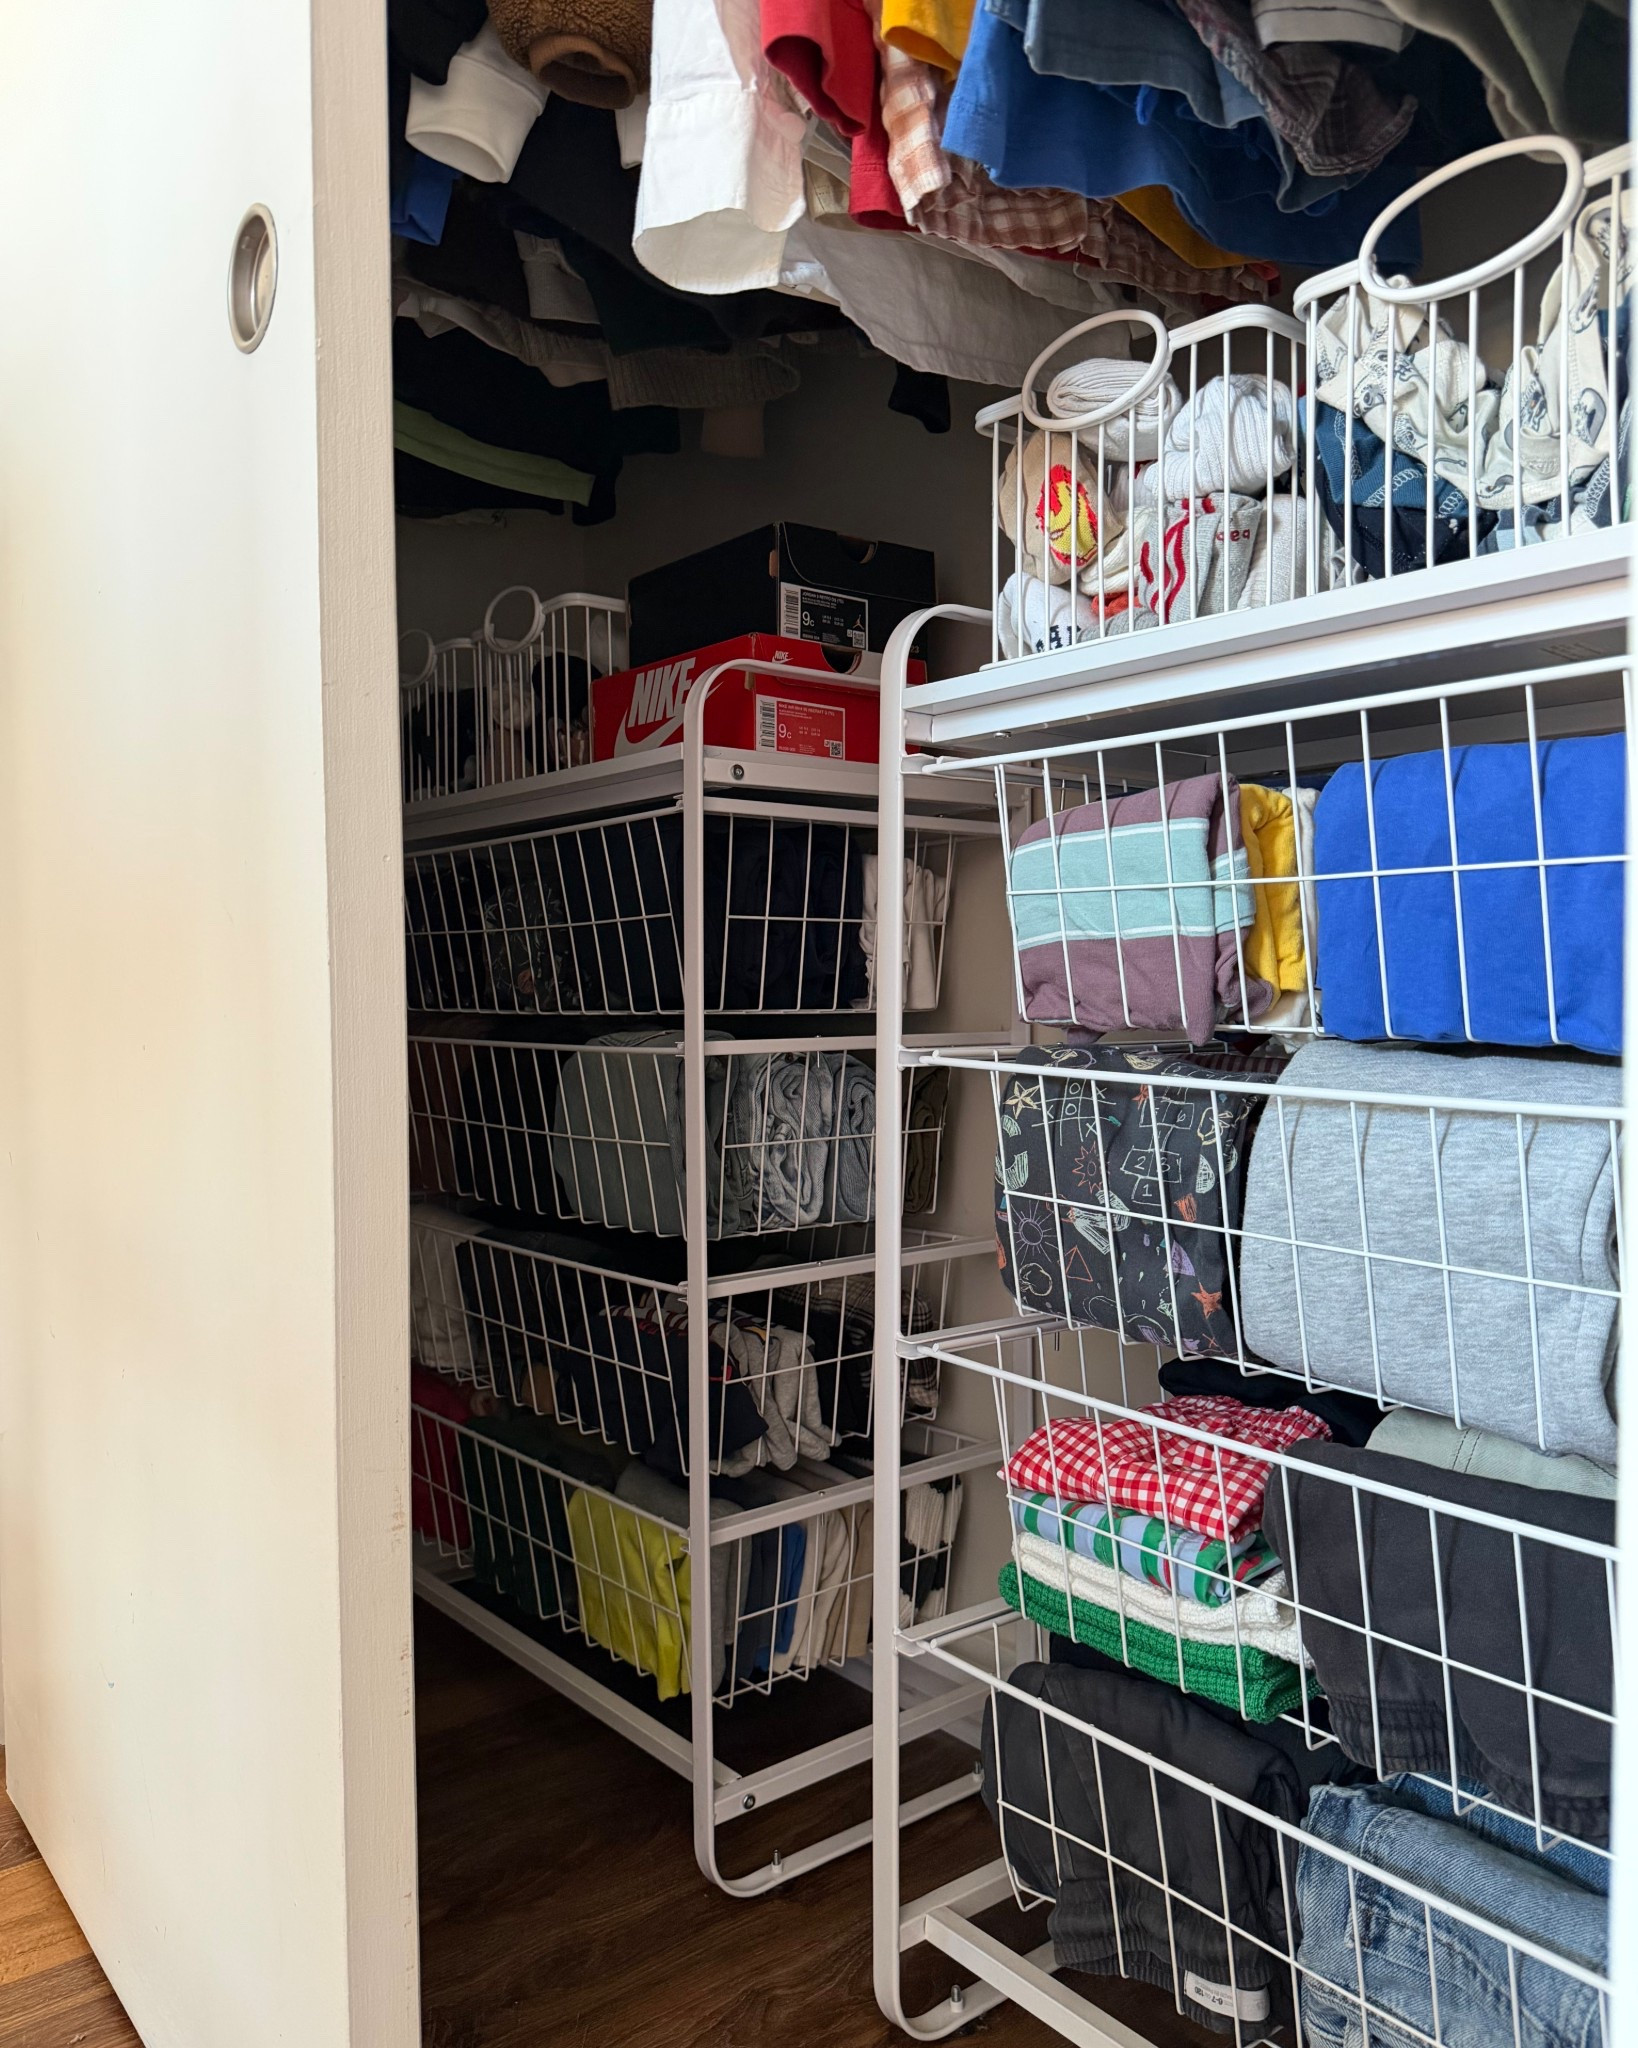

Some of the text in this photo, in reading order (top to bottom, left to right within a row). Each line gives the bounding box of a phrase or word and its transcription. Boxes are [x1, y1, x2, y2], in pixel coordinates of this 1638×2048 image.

[774, 650, 789, 660] NIKE
[628, 657, 697, 728] NIKE
[1134, 1156, 1146, 1170] 2
[1142, 1184, 1152, 1197] 1
